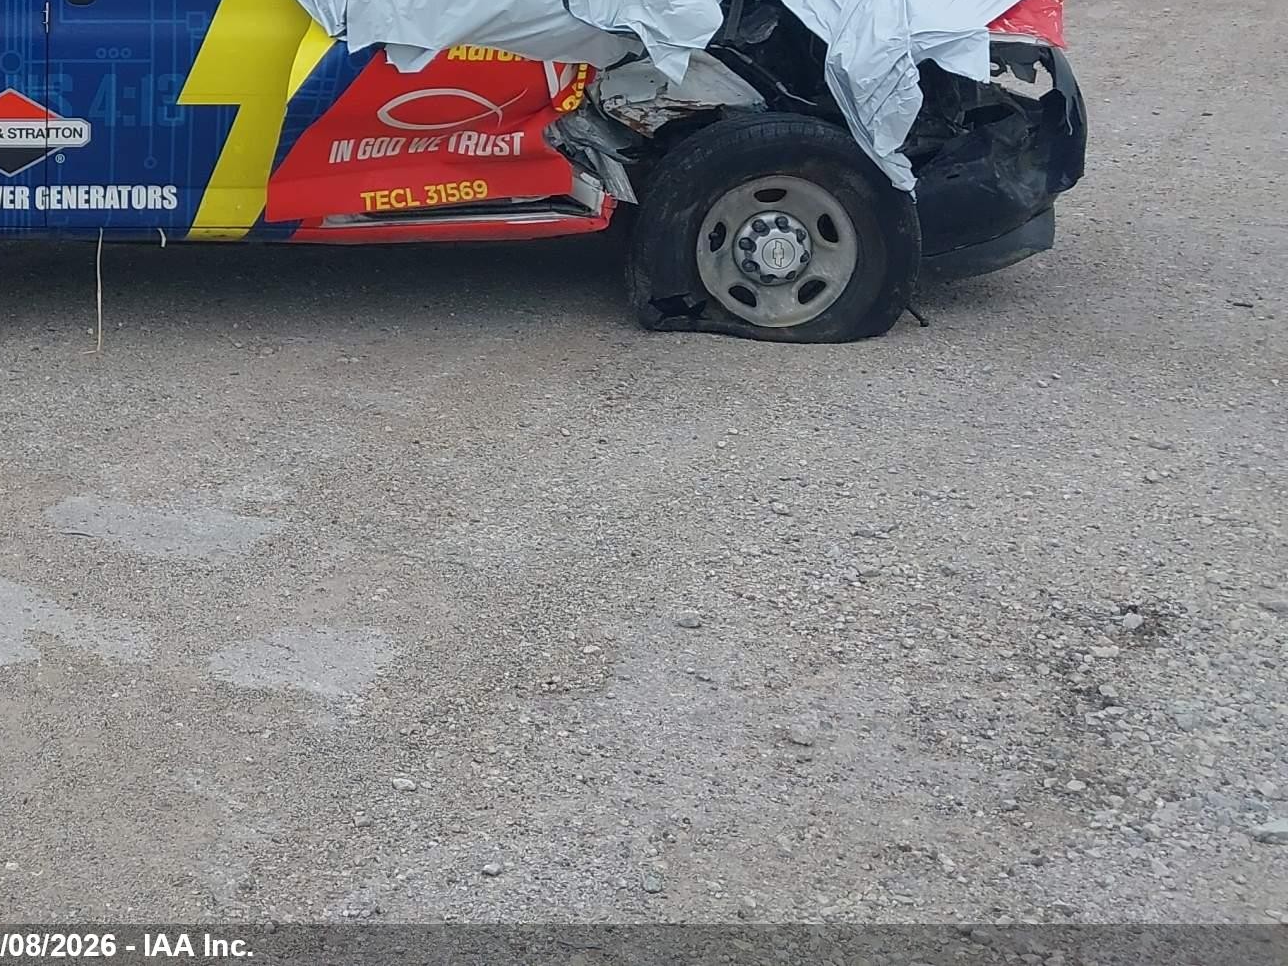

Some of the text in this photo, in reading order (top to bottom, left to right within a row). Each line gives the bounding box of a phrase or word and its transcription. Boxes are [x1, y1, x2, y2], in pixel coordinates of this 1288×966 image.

[7, 127, 83, 139] STRATTON
[328, 130, 525, 164] IN GOD WE TRUST
[34, 185, 178, 211] GENERATORS
[360, 179, 488, 211] TECL 31569
